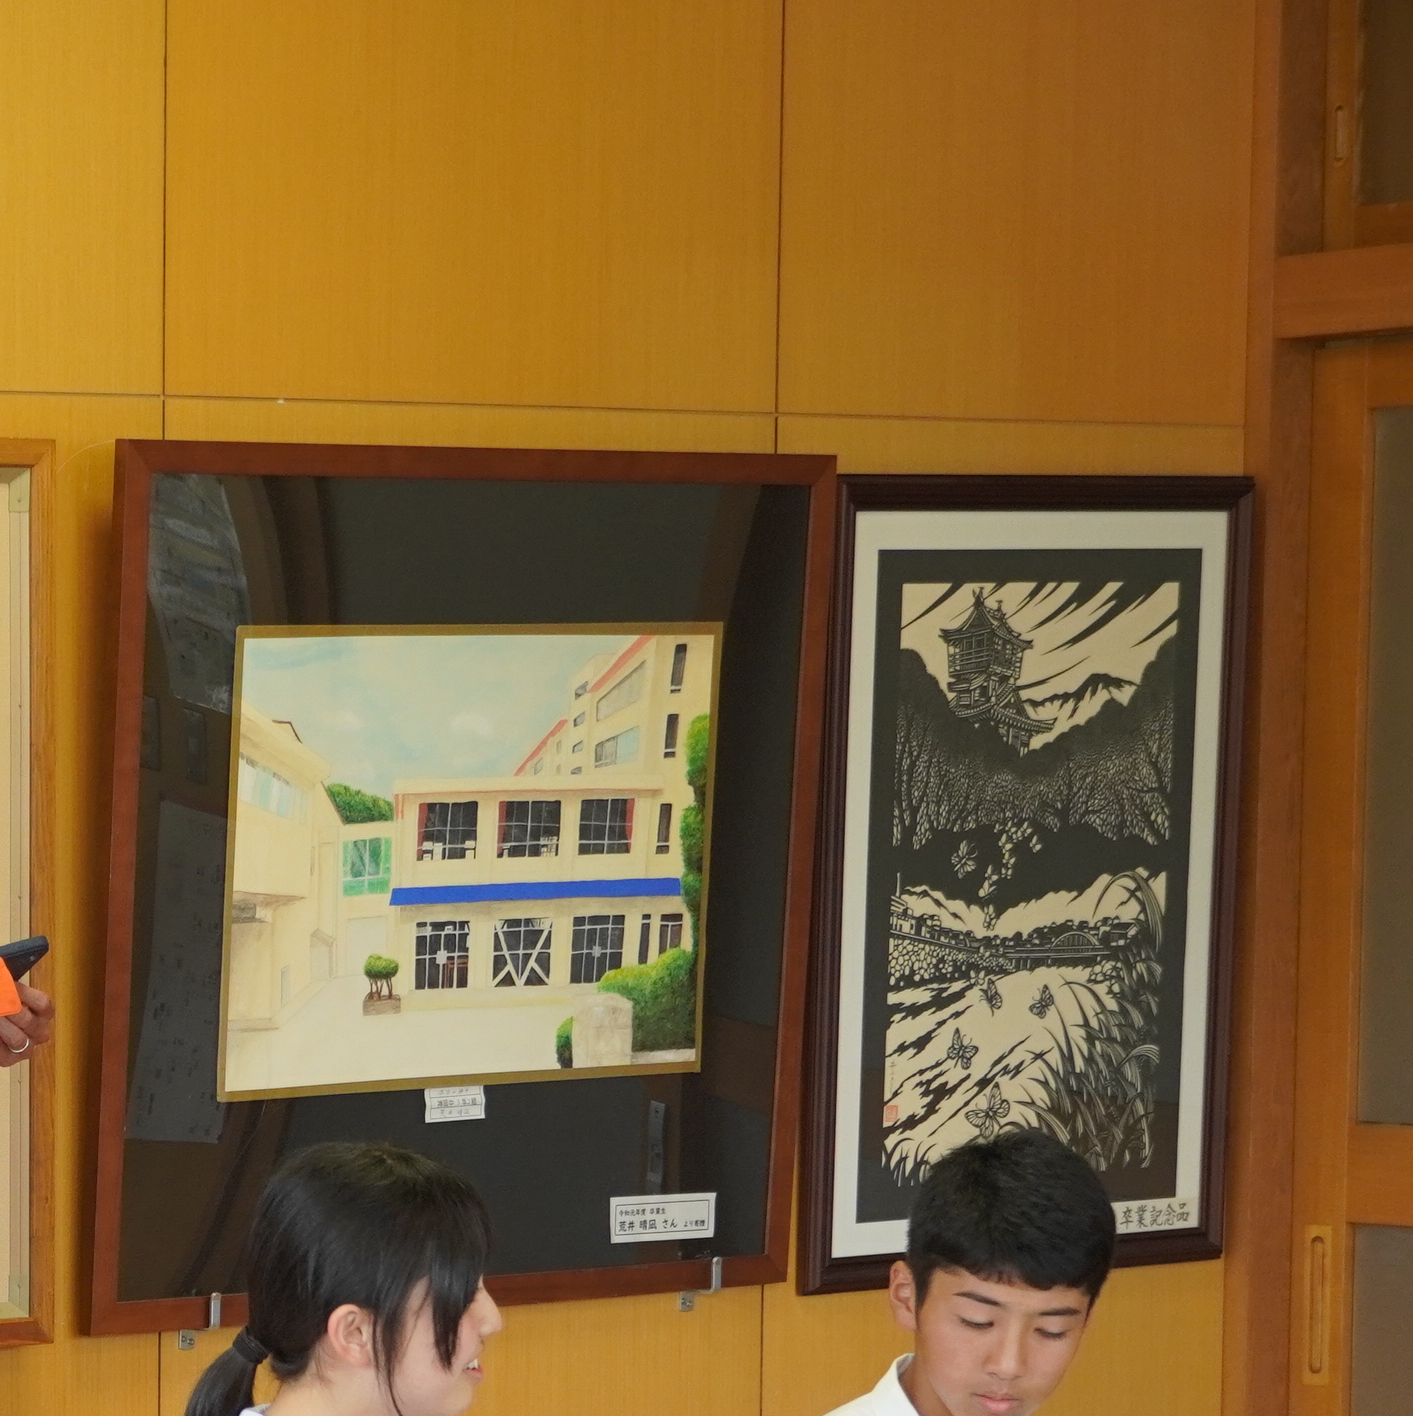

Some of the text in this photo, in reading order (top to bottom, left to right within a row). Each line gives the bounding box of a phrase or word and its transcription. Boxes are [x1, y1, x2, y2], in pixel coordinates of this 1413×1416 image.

[618, 1207, 647, 1218] 令和元年度
[1119, 1202, 1191, 1230] 卒業記念品
[661, 1218, 678, 1229] さん
